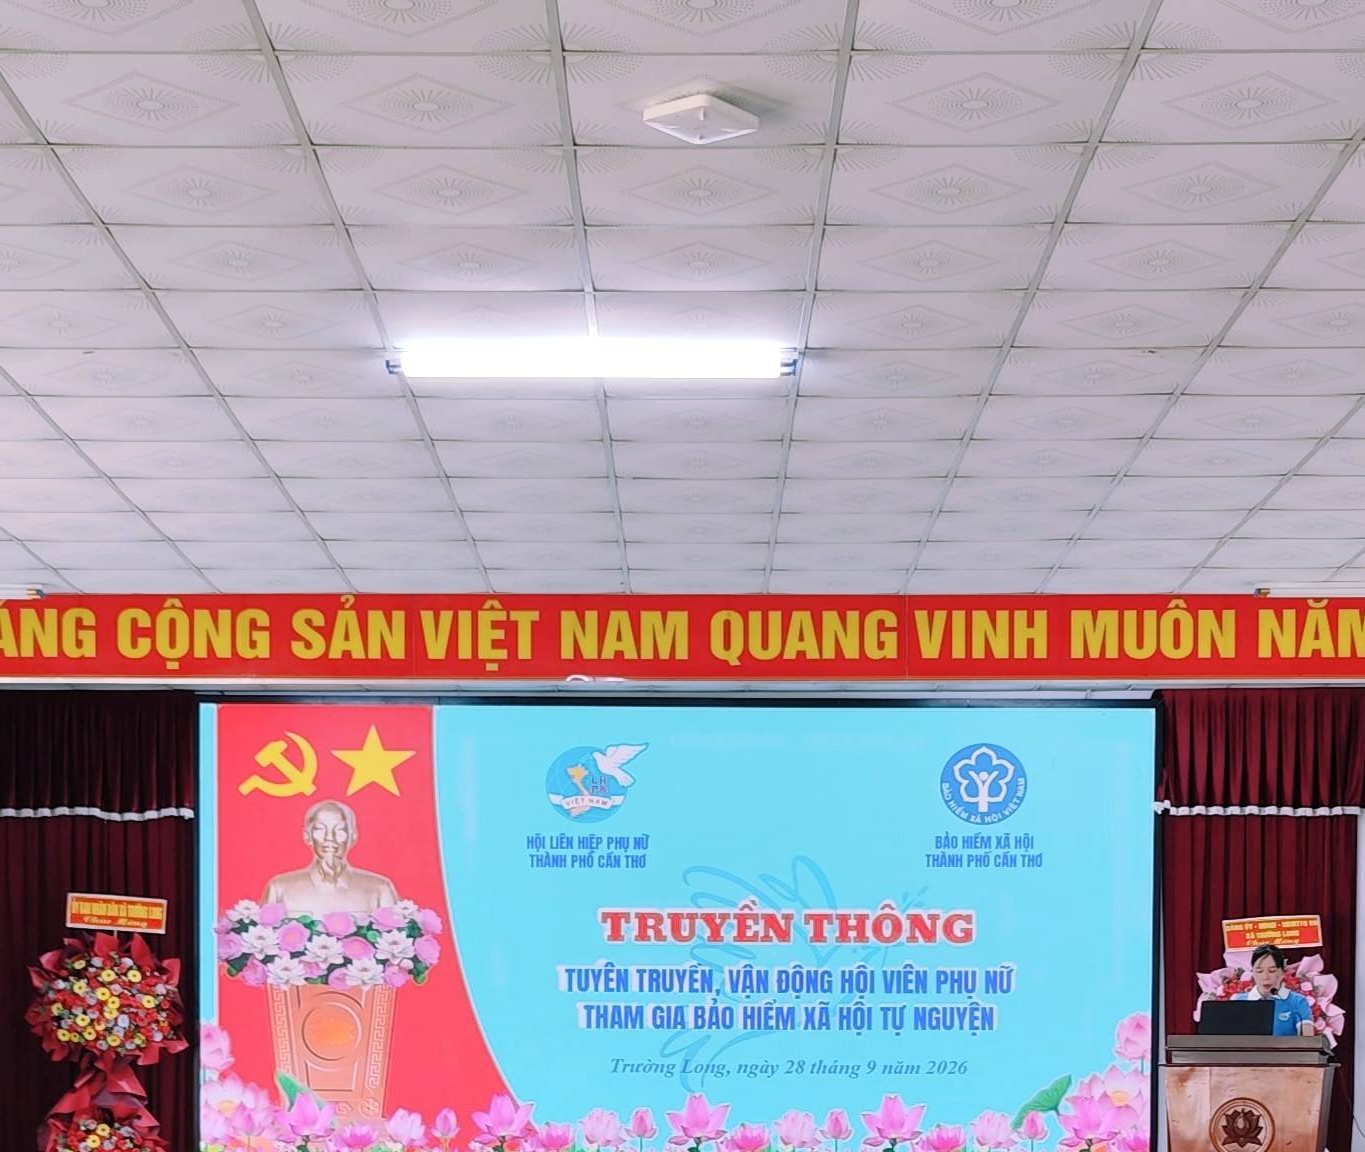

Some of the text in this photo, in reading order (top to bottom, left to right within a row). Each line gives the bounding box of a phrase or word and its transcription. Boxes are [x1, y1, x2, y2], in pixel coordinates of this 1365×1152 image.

[117, 598, 274, 670] CỘNG
[291, 595, 406, 660] SẢN
[420, 600, 540, 671] VIỆT
[561, 610, 689, 659] NAM
[710, 608, 898, 665] QUANG
[914, 610, 1046, 659] VINH
[1070, 598, 1236, 660] MUÔN
[601, 900, 974, 944] TRUYỀN THÔNG
[565, 962, 1014, 999] TUYÊN TRUYỀN, VẬN ĐỘNG HỘI VIÊN PHỤ NỮ
[583, 998, 994, 1036] THAM GIA BẢO HIỂM XÃ HỘI TỰ NGUYỆN
[611, 1058, 969, 1079] Trường Long, ngày 28 tháng 9 năm 2026
